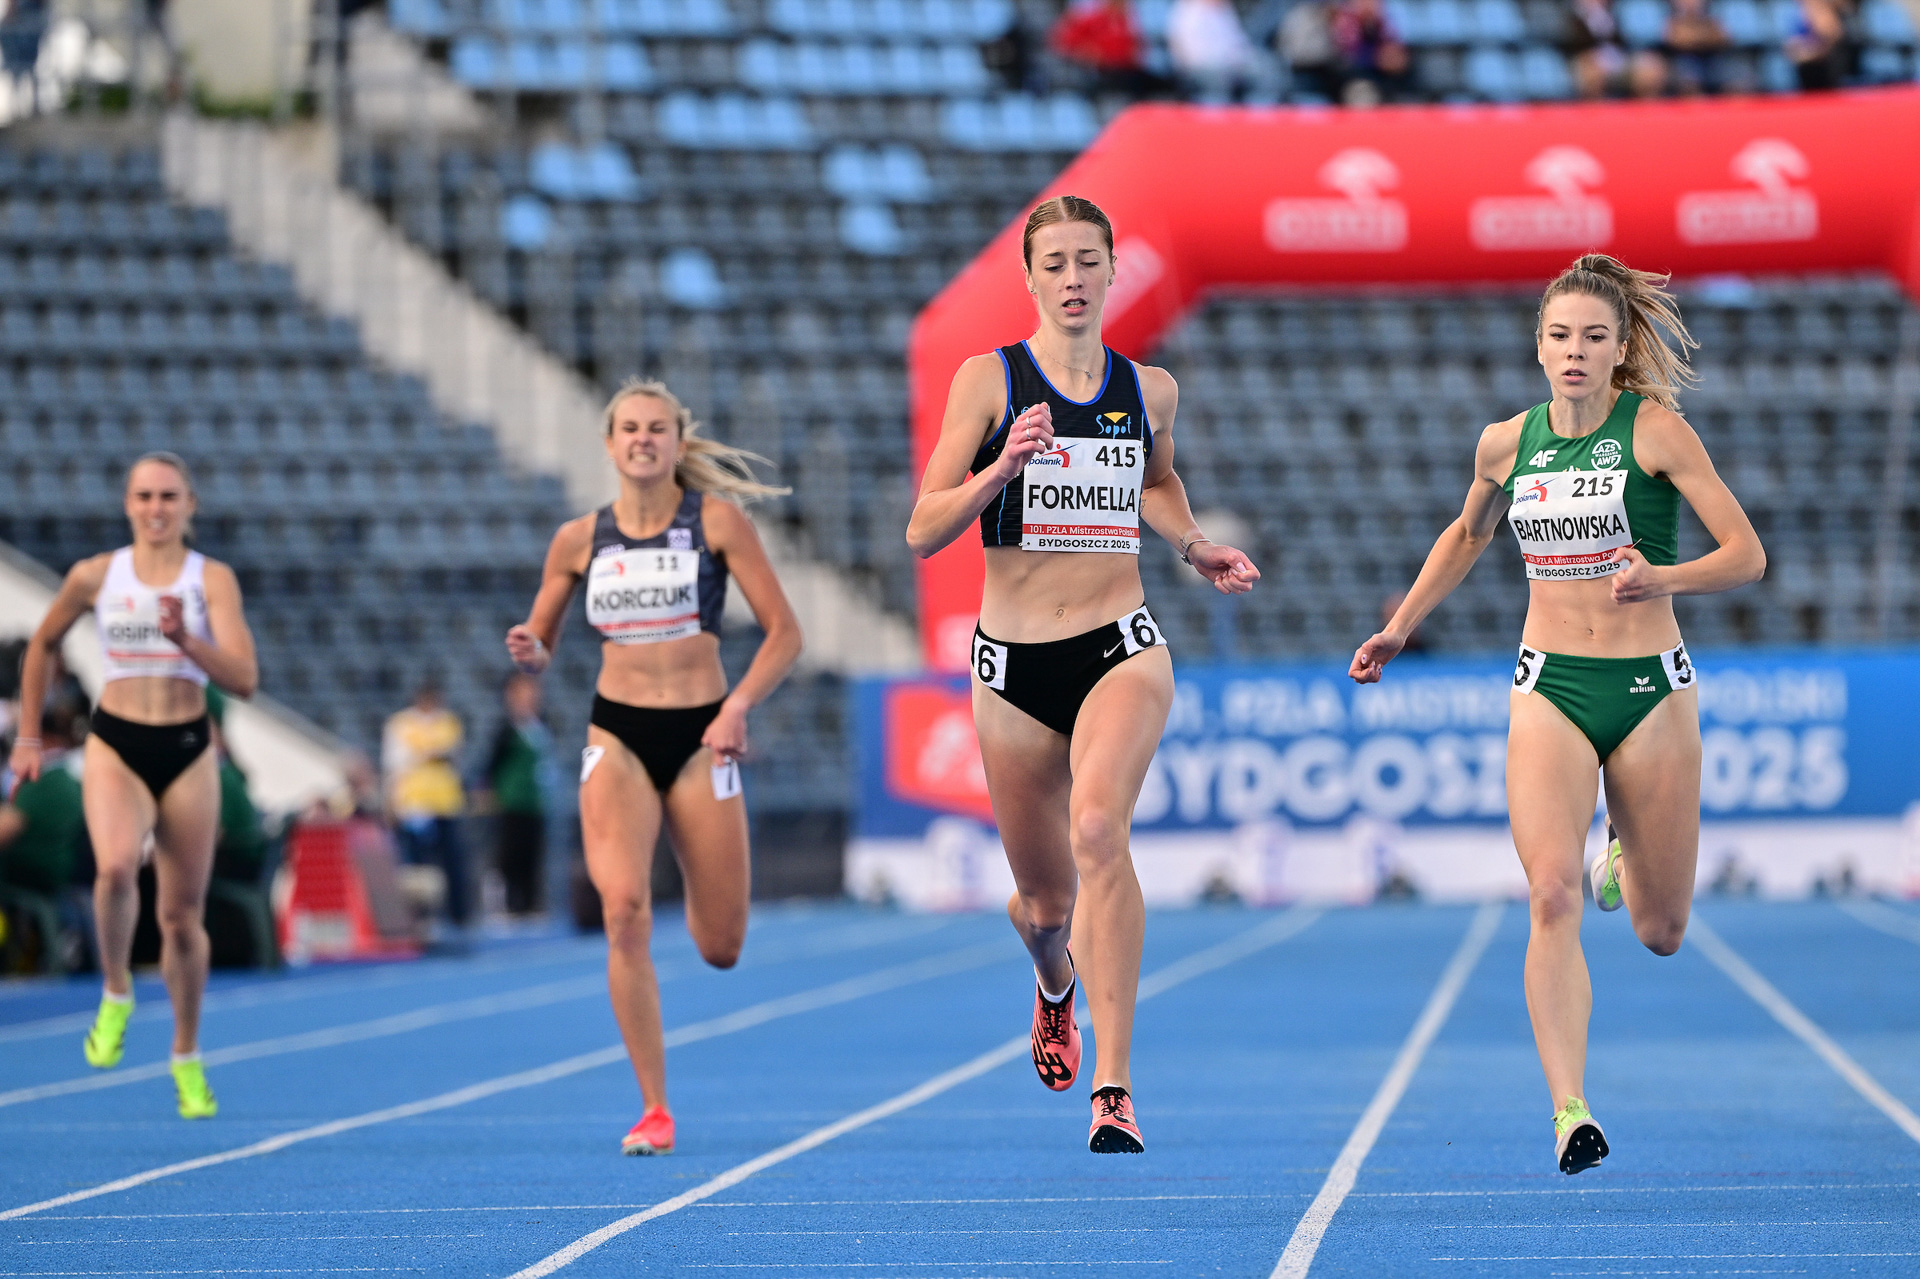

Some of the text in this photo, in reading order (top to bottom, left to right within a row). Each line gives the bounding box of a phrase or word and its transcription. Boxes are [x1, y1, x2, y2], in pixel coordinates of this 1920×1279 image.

[1095, 414, 1132, 440] Sopot
[1095, 445, 1137, 468] 415
[1528, 449, 1558, 468] 4F
[1598, 443, 1617, 453] AZS
[1028, 457, 1062, 466] polanik
[1596, 455, 1617, 466] AWF
[1028, 484, 1136, 512] FORMELLA
[1571, 476, 1614, 498] 215
[1029, 525, 1136, 537] 101. PZLA Mistrzostwa Polski
[1513, 513, 1626, 542] BARTNOWSKA
[1038, 538, 1131, 550] BYDGOSZCZ 2025
[656, 555, 679, 571] 11
[1535, 563, 1621, 577] BYDGOSZCZ 2025
[1536, 557, 1554, 565] PZLA
[1554, 555, 1601, 565] Mistrzostwa
[592, 586, 692, 613] KORCZUK
[1130, 612, 1156, 648] 6
[977, 644, 997, 683] 6
[1514, 648, 1536, 686] 5
[1673, 646, 1692, 685] 5
[1701, 725, 1850, 813] 025
